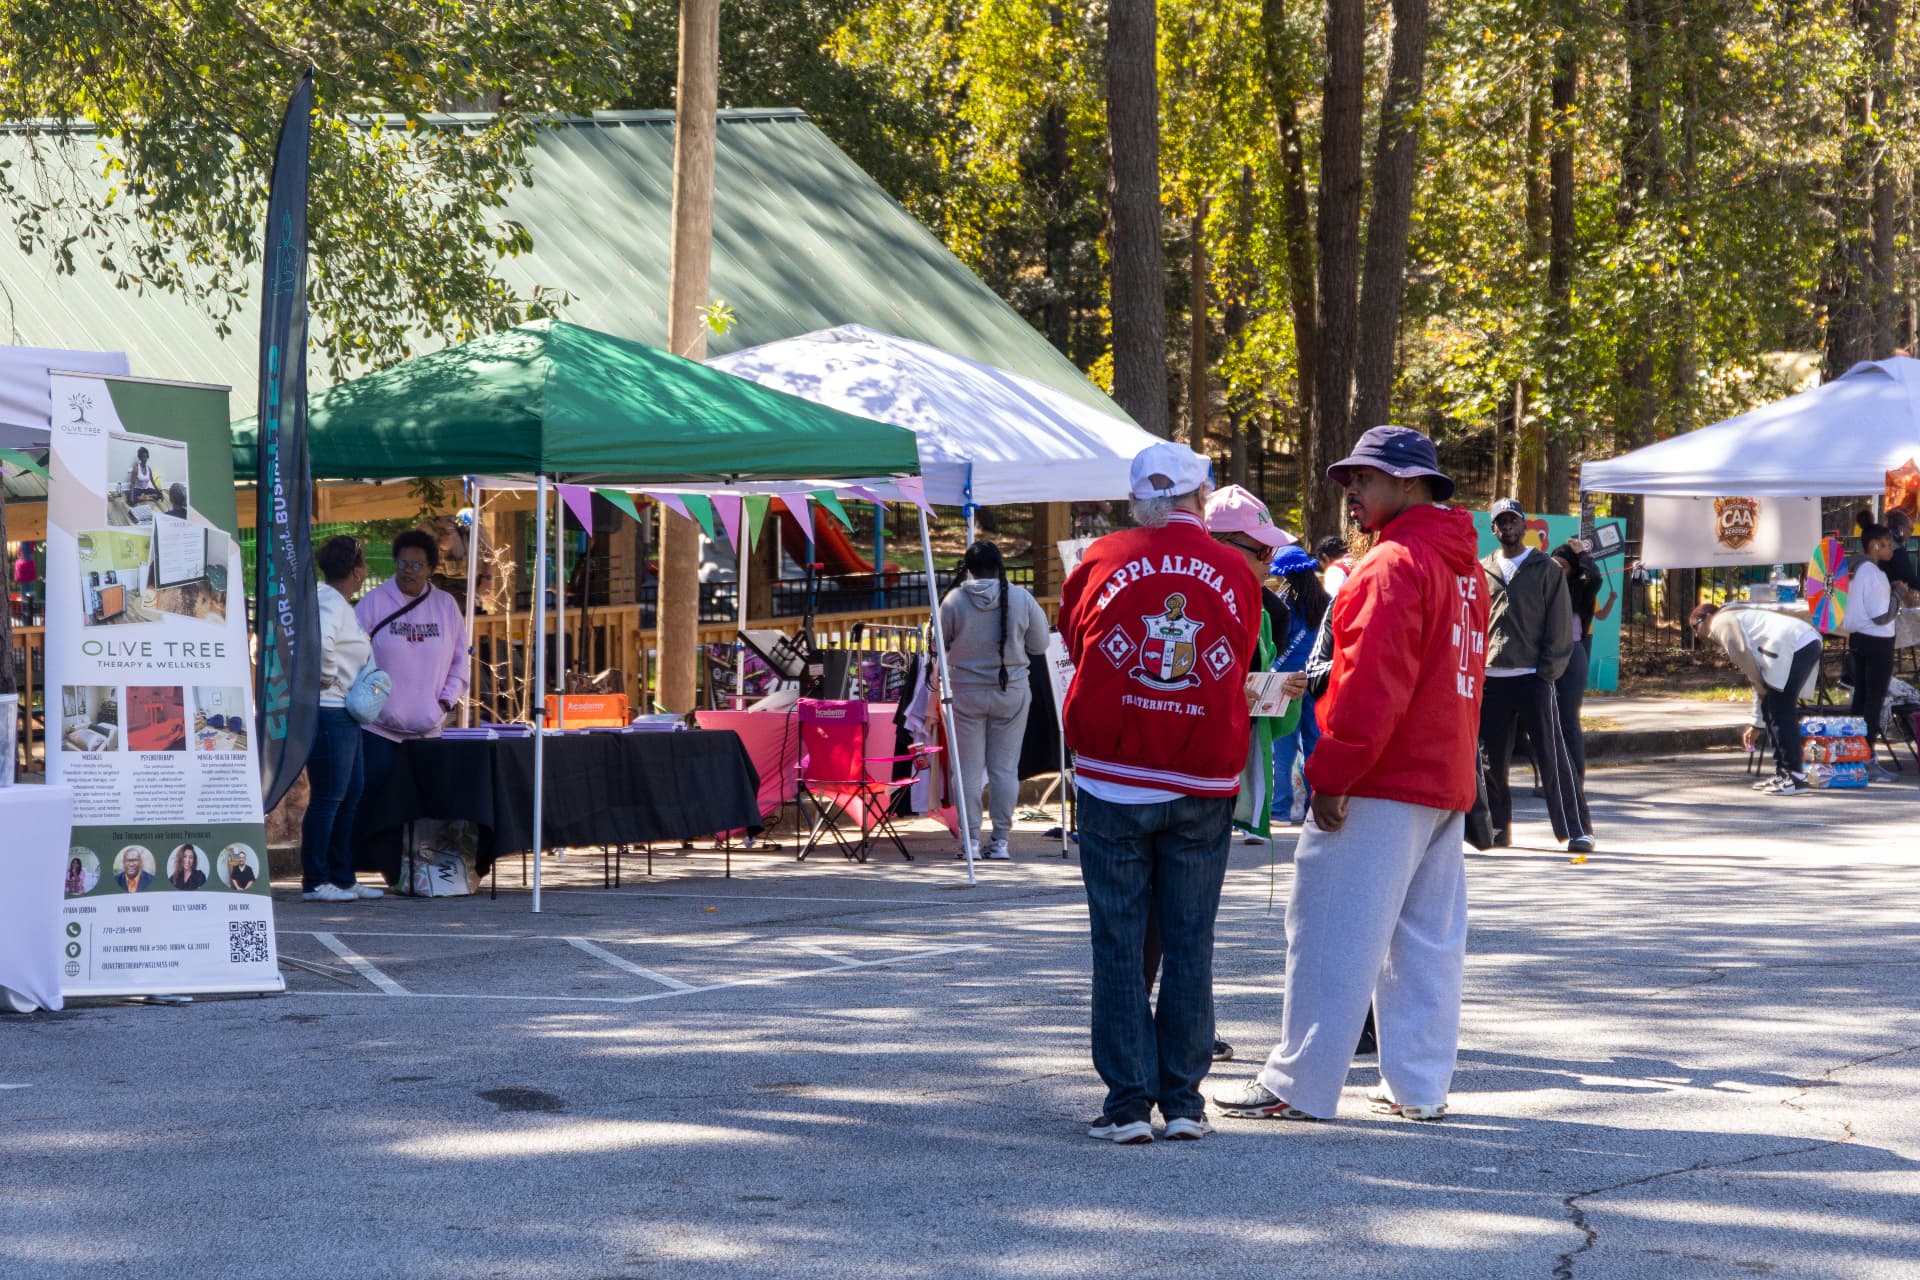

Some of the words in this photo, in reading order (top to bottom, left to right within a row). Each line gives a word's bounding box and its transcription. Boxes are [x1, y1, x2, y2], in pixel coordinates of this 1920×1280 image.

[1721, 509, 1754, 528] CAA
[1096, 556, 1156, 610] KAPPA
[1160, 554, 1224, 592] ALPHA
[1222, 588, 1240, 622] PS
[82, 640, 152, 657] OLIVE
[164, 642, 225, 658] TREE
[156, 661, 211, 669] WELLNESS
